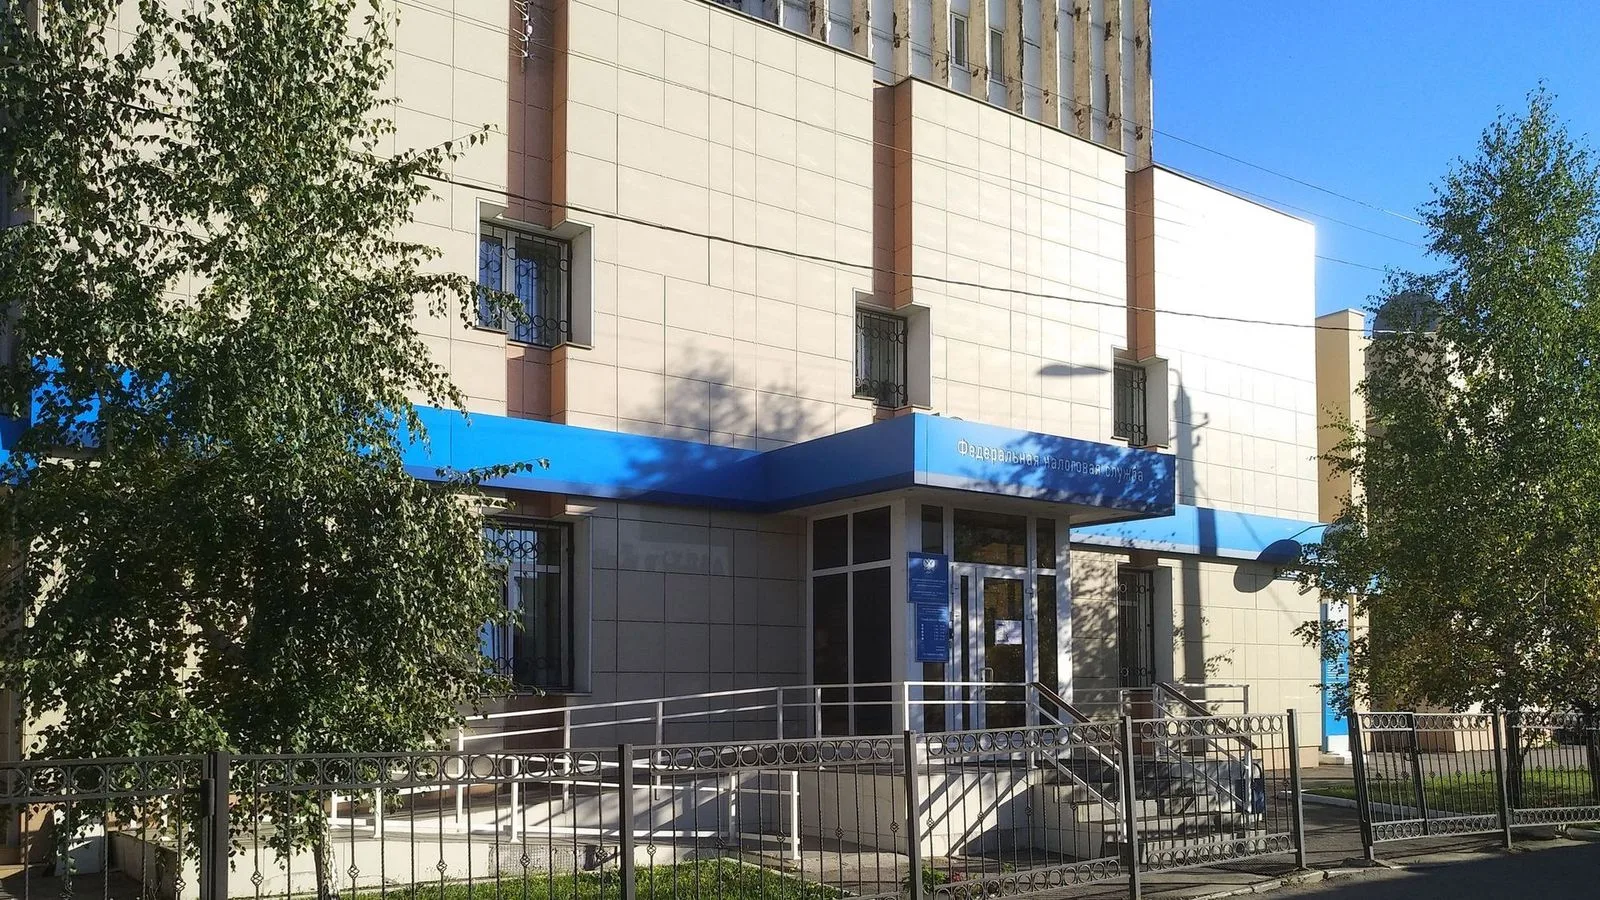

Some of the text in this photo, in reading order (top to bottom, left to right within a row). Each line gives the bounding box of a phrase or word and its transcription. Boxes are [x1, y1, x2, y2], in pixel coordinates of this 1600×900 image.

[957, 438, 1144, 483] Федеральная налоговая служба
